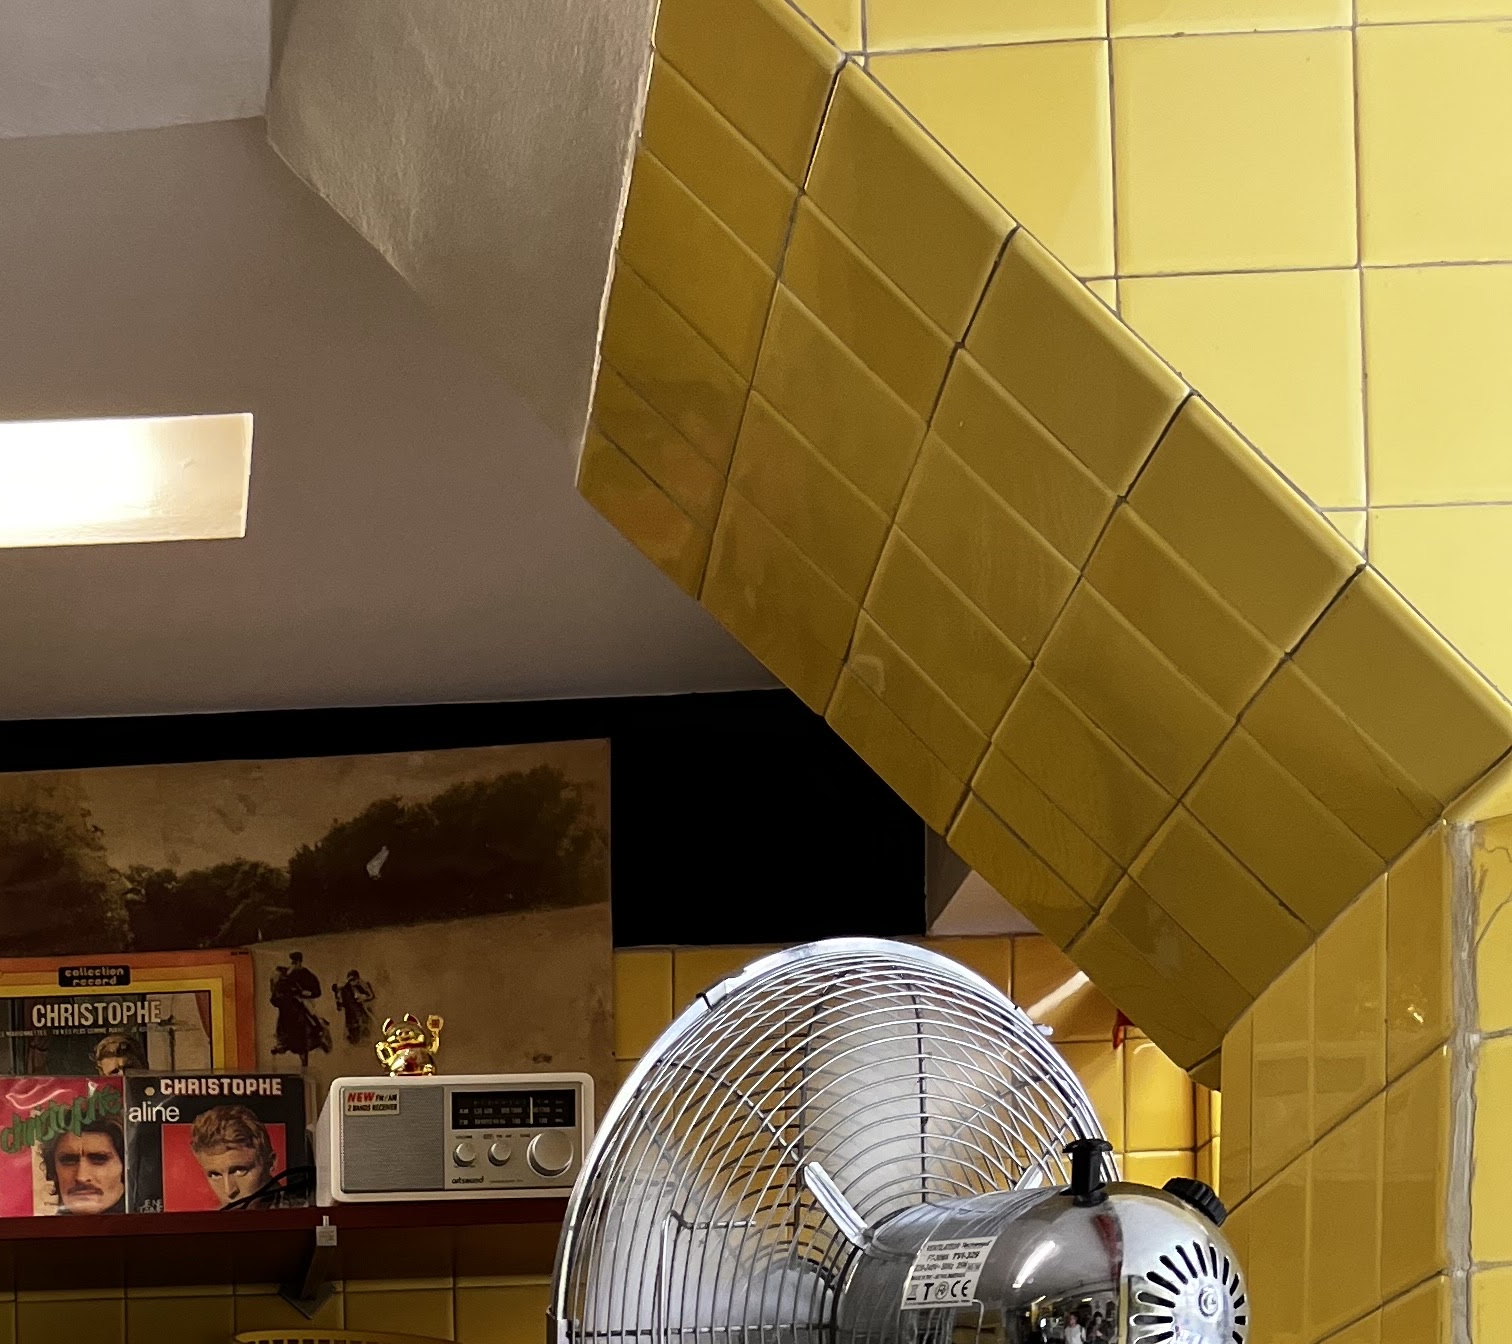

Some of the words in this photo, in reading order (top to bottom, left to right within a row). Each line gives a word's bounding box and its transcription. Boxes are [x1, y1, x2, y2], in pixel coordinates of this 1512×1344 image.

[64, 967, 125, 978] collection
[72, 976, 117, 987] record
[31, 1000, 163, 1028] CHRISTOPHE
[159, 1077, 284, 1097] CHRISTOPHE
[347, 1091, 376, 1103] NEW
[128, 1100, 181, 1123] aline
